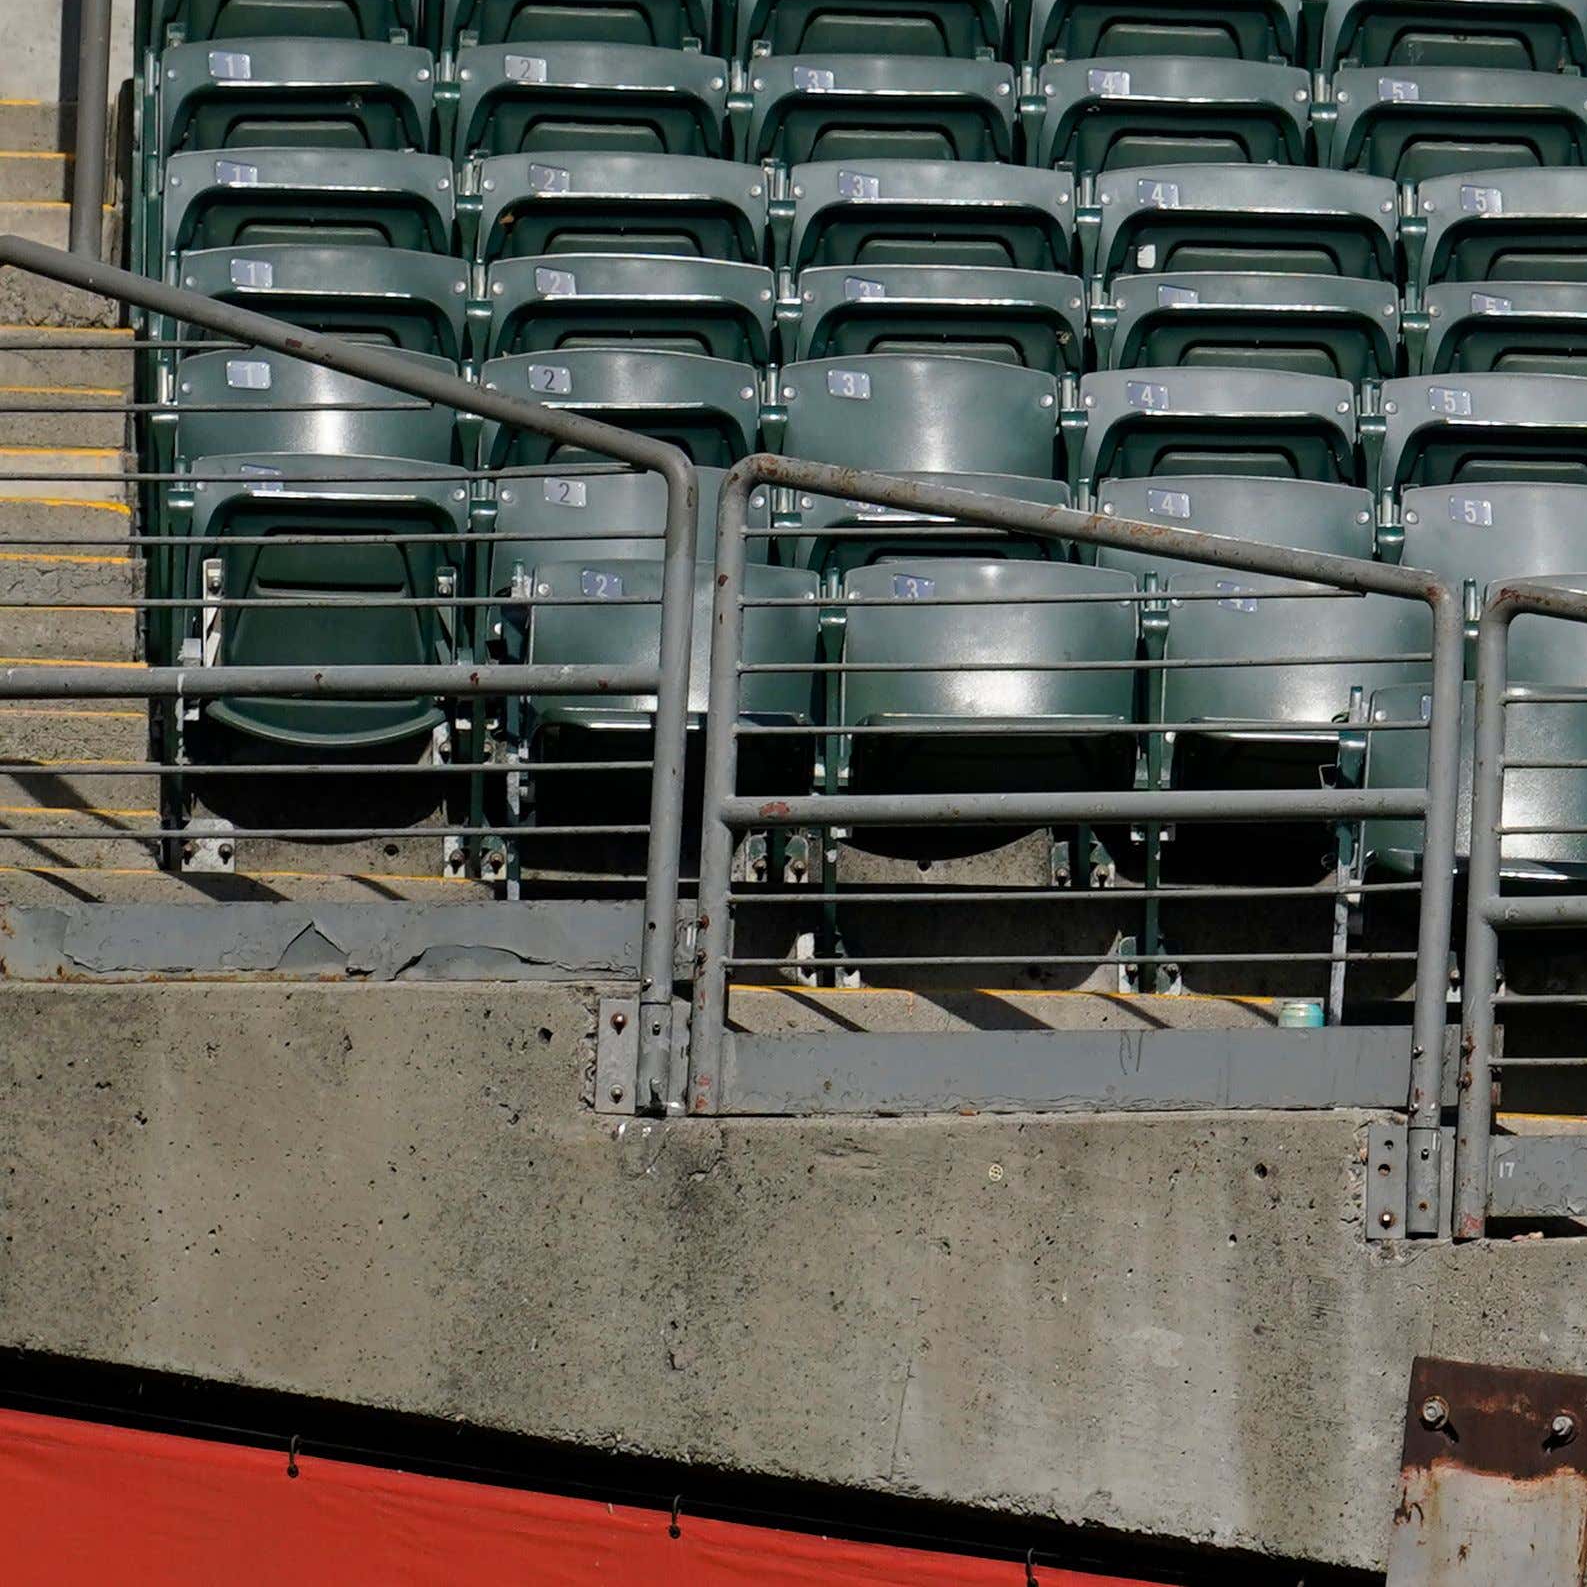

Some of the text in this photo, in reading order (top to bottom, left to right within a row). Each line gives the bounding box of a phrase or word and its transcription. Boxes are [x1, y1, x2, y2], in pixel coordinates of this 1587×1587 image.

[226, 56, 234, 77] 1
[520, 60, 531, 80] 2
[807, 69, 818, 89] 3
[1102, 71, 1114, 92] 4
[1392, 82, 1404, 101] 5
[232, 164, 241, 182] 1
[543, 171, 555, 192] 2
[852, 175, 863, 198] 3
[1151, 183, 1164, 205] 4
[1475, 189, 1486, 210] 5
[248, 263, 256, 283] 1
[549, 274, 561, 293] 2
[244, 364, 254, 383] 1
[543, 369, 555, 390] 2
[842, 374, 854, 396] 3
[1141, 385, 1153, 405] 4
[1443, 391, 1456, 413] 5
[559, 482, 570, 504] 2
[1161, 493, 1174, 514] 4
[1464, 499, 1476, 523] 5
[595, 575, 608, 597] 2
[907, 578, 920, 598] 3
[1499, 1163, 1514, 1179] 17
